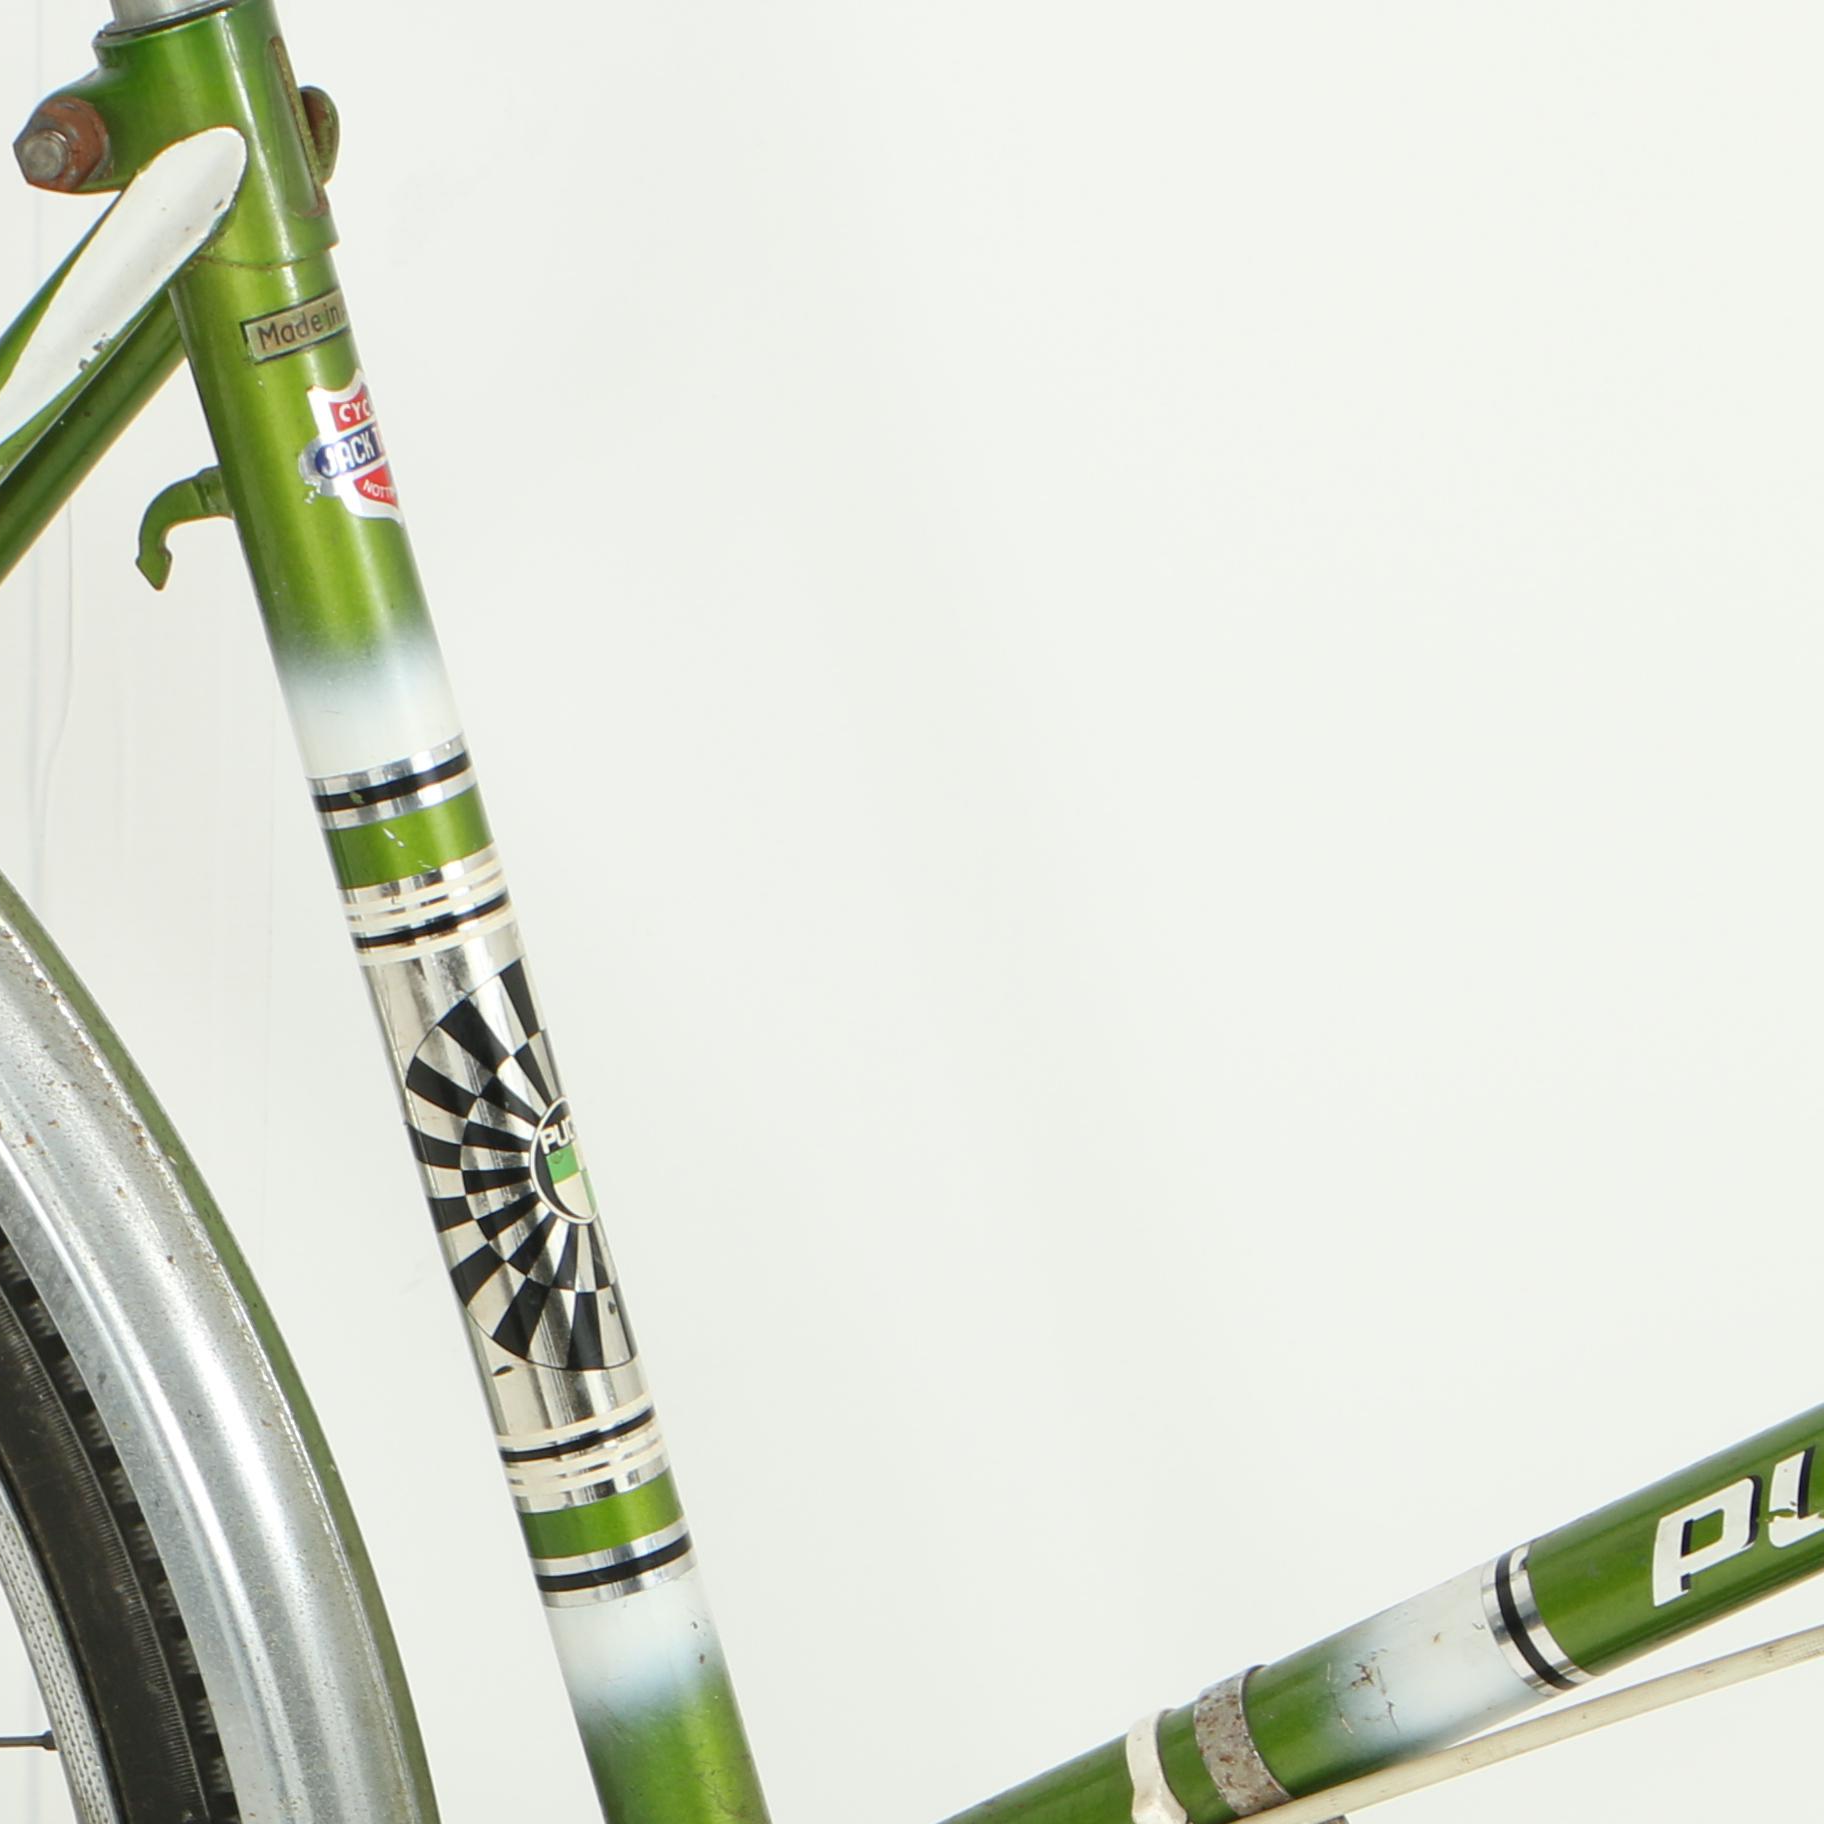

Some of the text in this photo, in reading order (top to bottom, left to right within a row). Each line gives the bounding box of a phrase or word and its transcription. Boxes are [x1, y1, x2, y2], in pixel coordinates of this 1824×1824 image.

[257, 311, 324, 351] Made
[323, 303, 341, 329] in
[320, 431, 376, 478] JACK
